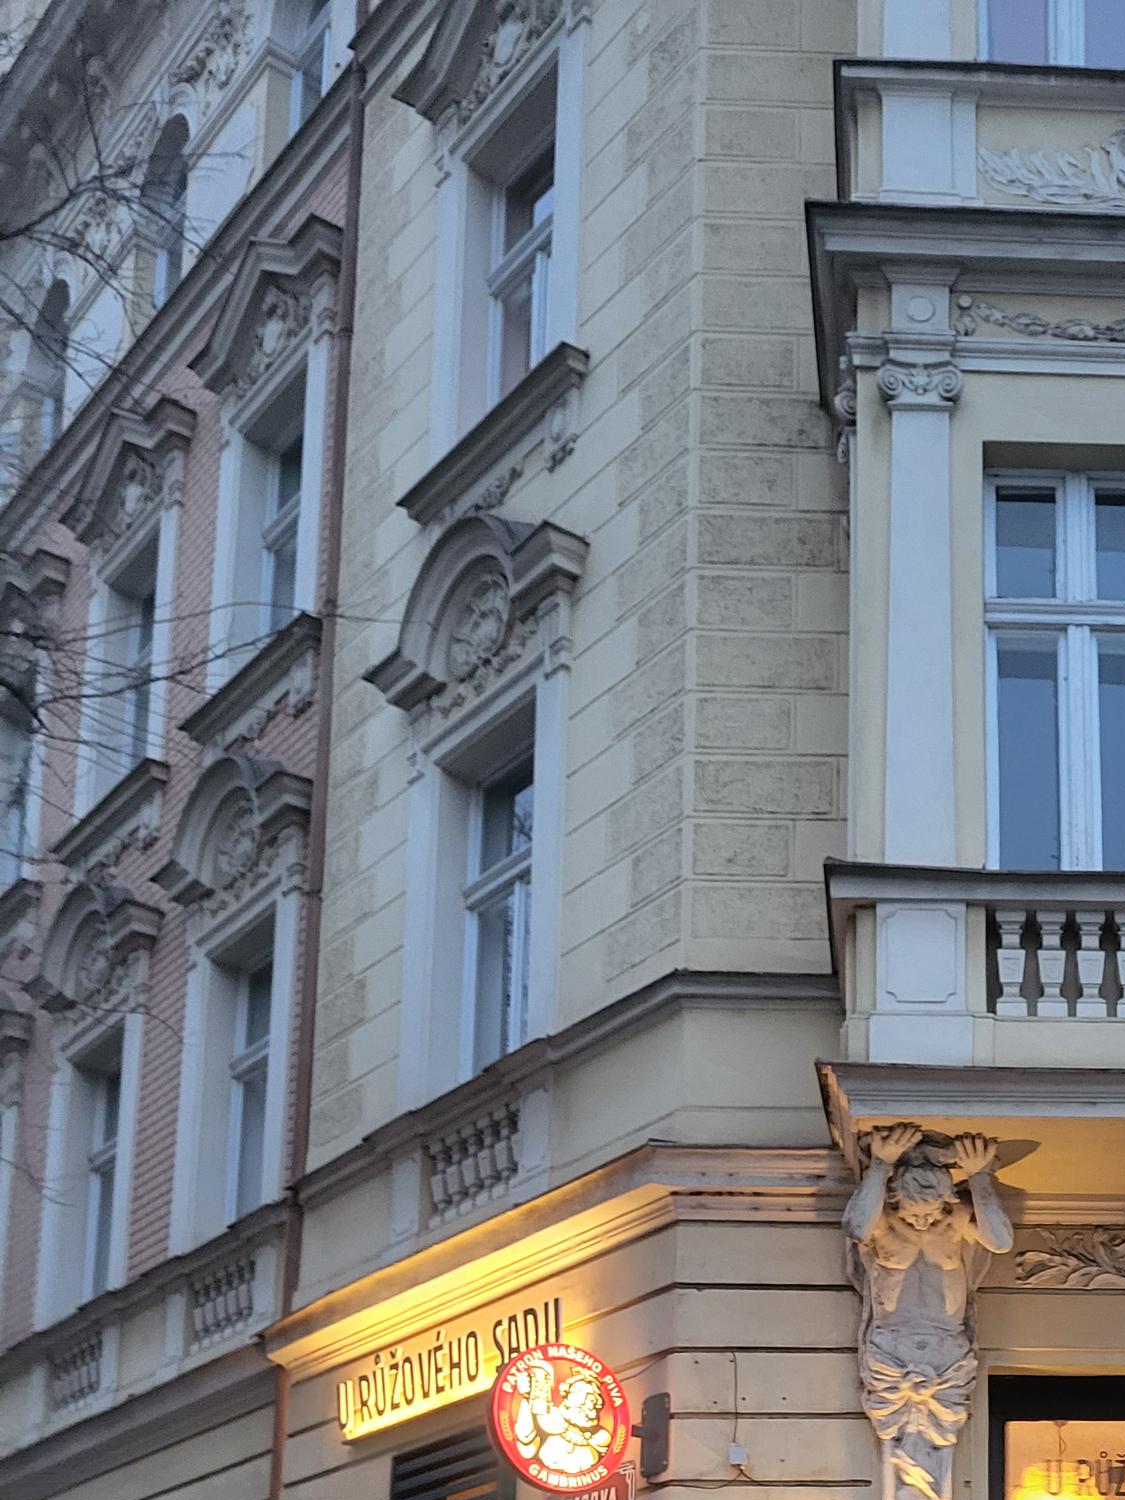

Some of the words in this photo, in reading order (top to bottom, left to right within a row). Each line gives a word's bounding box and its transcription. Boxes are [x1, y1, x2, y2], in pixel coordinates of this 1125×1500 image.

[337, 1381, 354, 1429] U
[359, 1329, 479, 1422] RŮŽOVÉHO
[492, 1297, 561, 1373] SADU
[502, 1349, 544, 1392] PATRON
[548, 1346, 602, 1373] NAŠEHO
[602, 1375, 623, 1407] PIVA
[528, 1464, 608, 1488] GAMBRINUS
[1046, 1459, 1063, 1496] U
